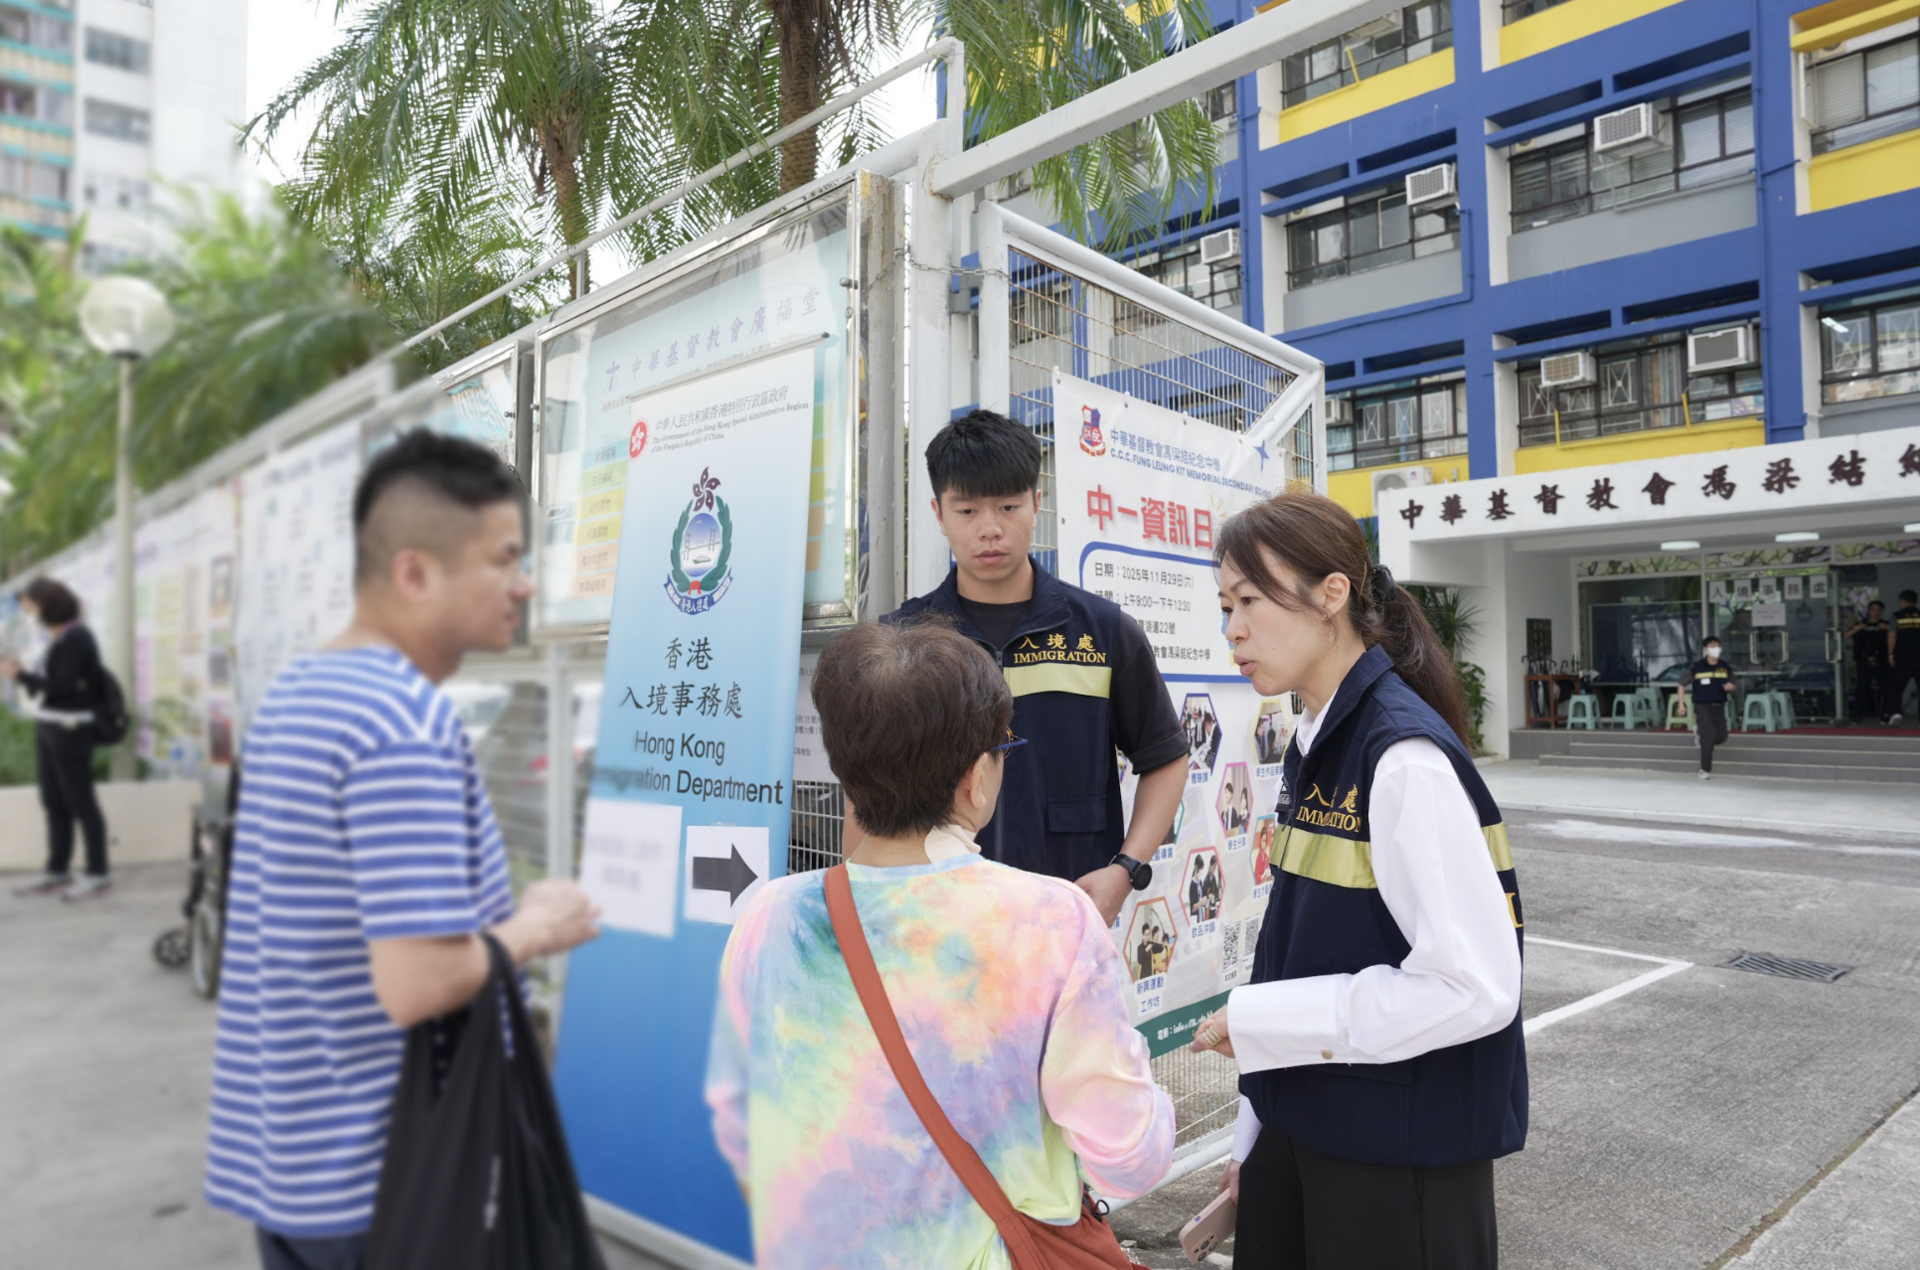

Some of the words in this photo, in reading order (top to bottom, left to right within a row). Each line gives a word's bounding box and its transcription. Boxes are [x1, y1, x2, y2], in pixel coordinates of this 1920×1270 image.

[631, 287, 820, 380] 中華基督教會廣福堂
[653, 436, 661, 444] The
[661, 431, 690, 442] Government
[703, 424, 716, 434] Hong
[717, 420, 731, 431] Kong
[732, 416, 748, 427] Special
[749, 407, 785, 420] Administrative
[786, 402, 809, 412] Region
[655, 385, 789, 433] 中華人民共和國香港特別行政區政府
[663, 441, 684, 452] People's
[684, 437, 702, 447] Republic
[708, 432, 725, 441] China
[1110, 428, 1222, 473] 中華基督教會馮梁結紀念中學
[1110, 448, 1132, 463] C.C.C.
[1132, 456, 1151, 469] FUNG
[1152, 460, 1175, 474] LEUNG
[1176, 465, 1186, 477] KIT
[1186, 468, 1221, 485] MEMORIAL
[1221, 477, 1254, 493] SECONDARY
[1254, 486, 1273, 499] SCHOO
[1086, 484, 1214, 550] 中一資訊日
[1712, 581, 1826, 599] 入境事務處
[664, 636, 714, 670] 香港
[1013, 650, 1107, 664] IMMIGRATION
[1018, 633, 1096, 652] 入境處
[618, 681, 744, 720] 入境事務處
[634, 730, 675, 761] Hong
[680, 733, 726, 766] Kong
[677, 770, 783, 804] Department
[1304, 783, 1358, 813] 入處
